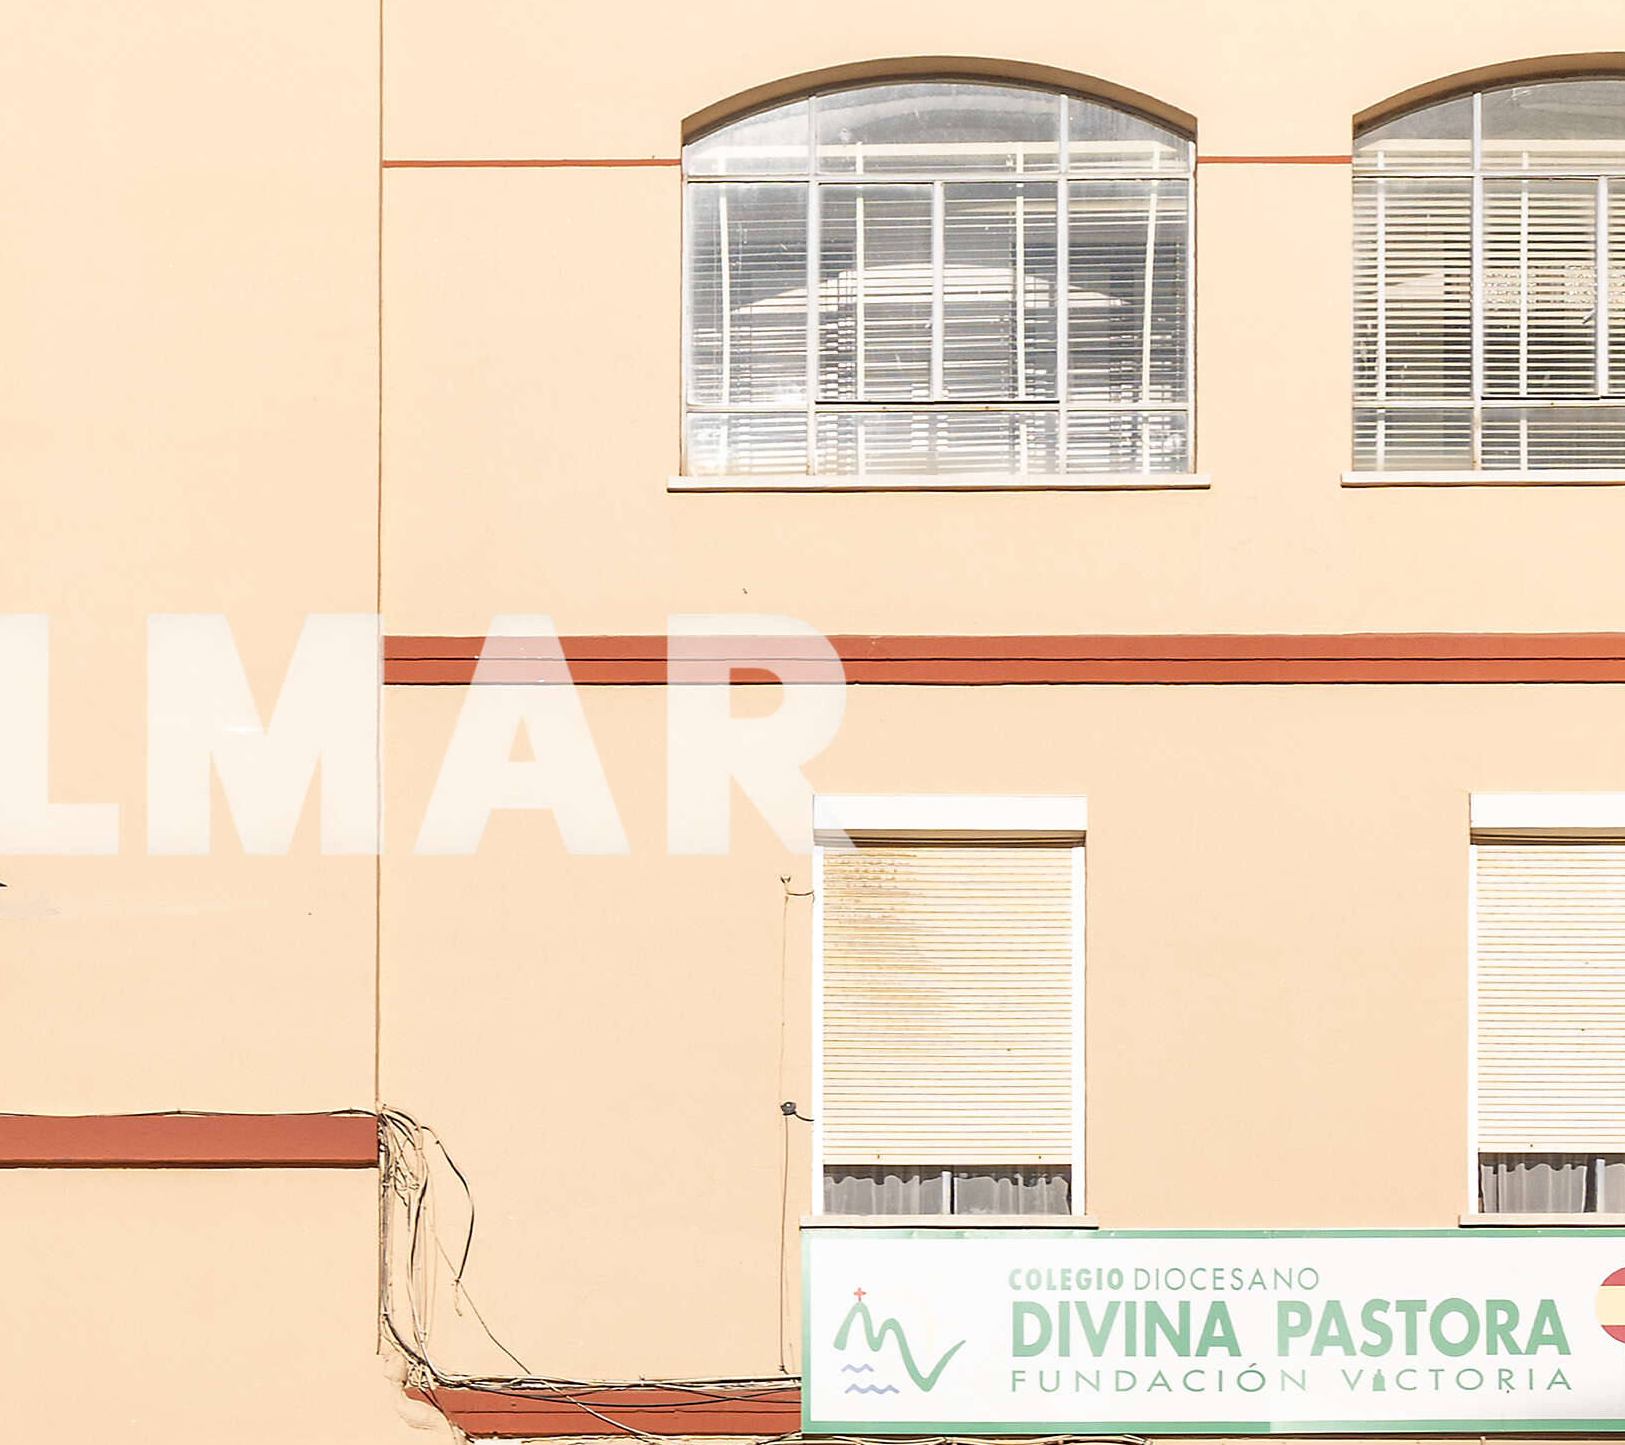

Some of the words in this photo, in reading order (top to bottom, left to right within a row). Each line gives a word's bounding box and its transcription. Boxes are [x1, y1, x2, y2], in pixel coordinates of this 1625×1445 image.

[1008, 1267, 1124, 1291] COLEGIO
[1134, 1267, 1319, 1291] DIOCESANO
[1012, 1300, 1242, 1357] DIVINA
[1277, 1297, 1572, 1357] PASTORA
[1011, 1362, 1306, 1393] FUNDACIÓN
